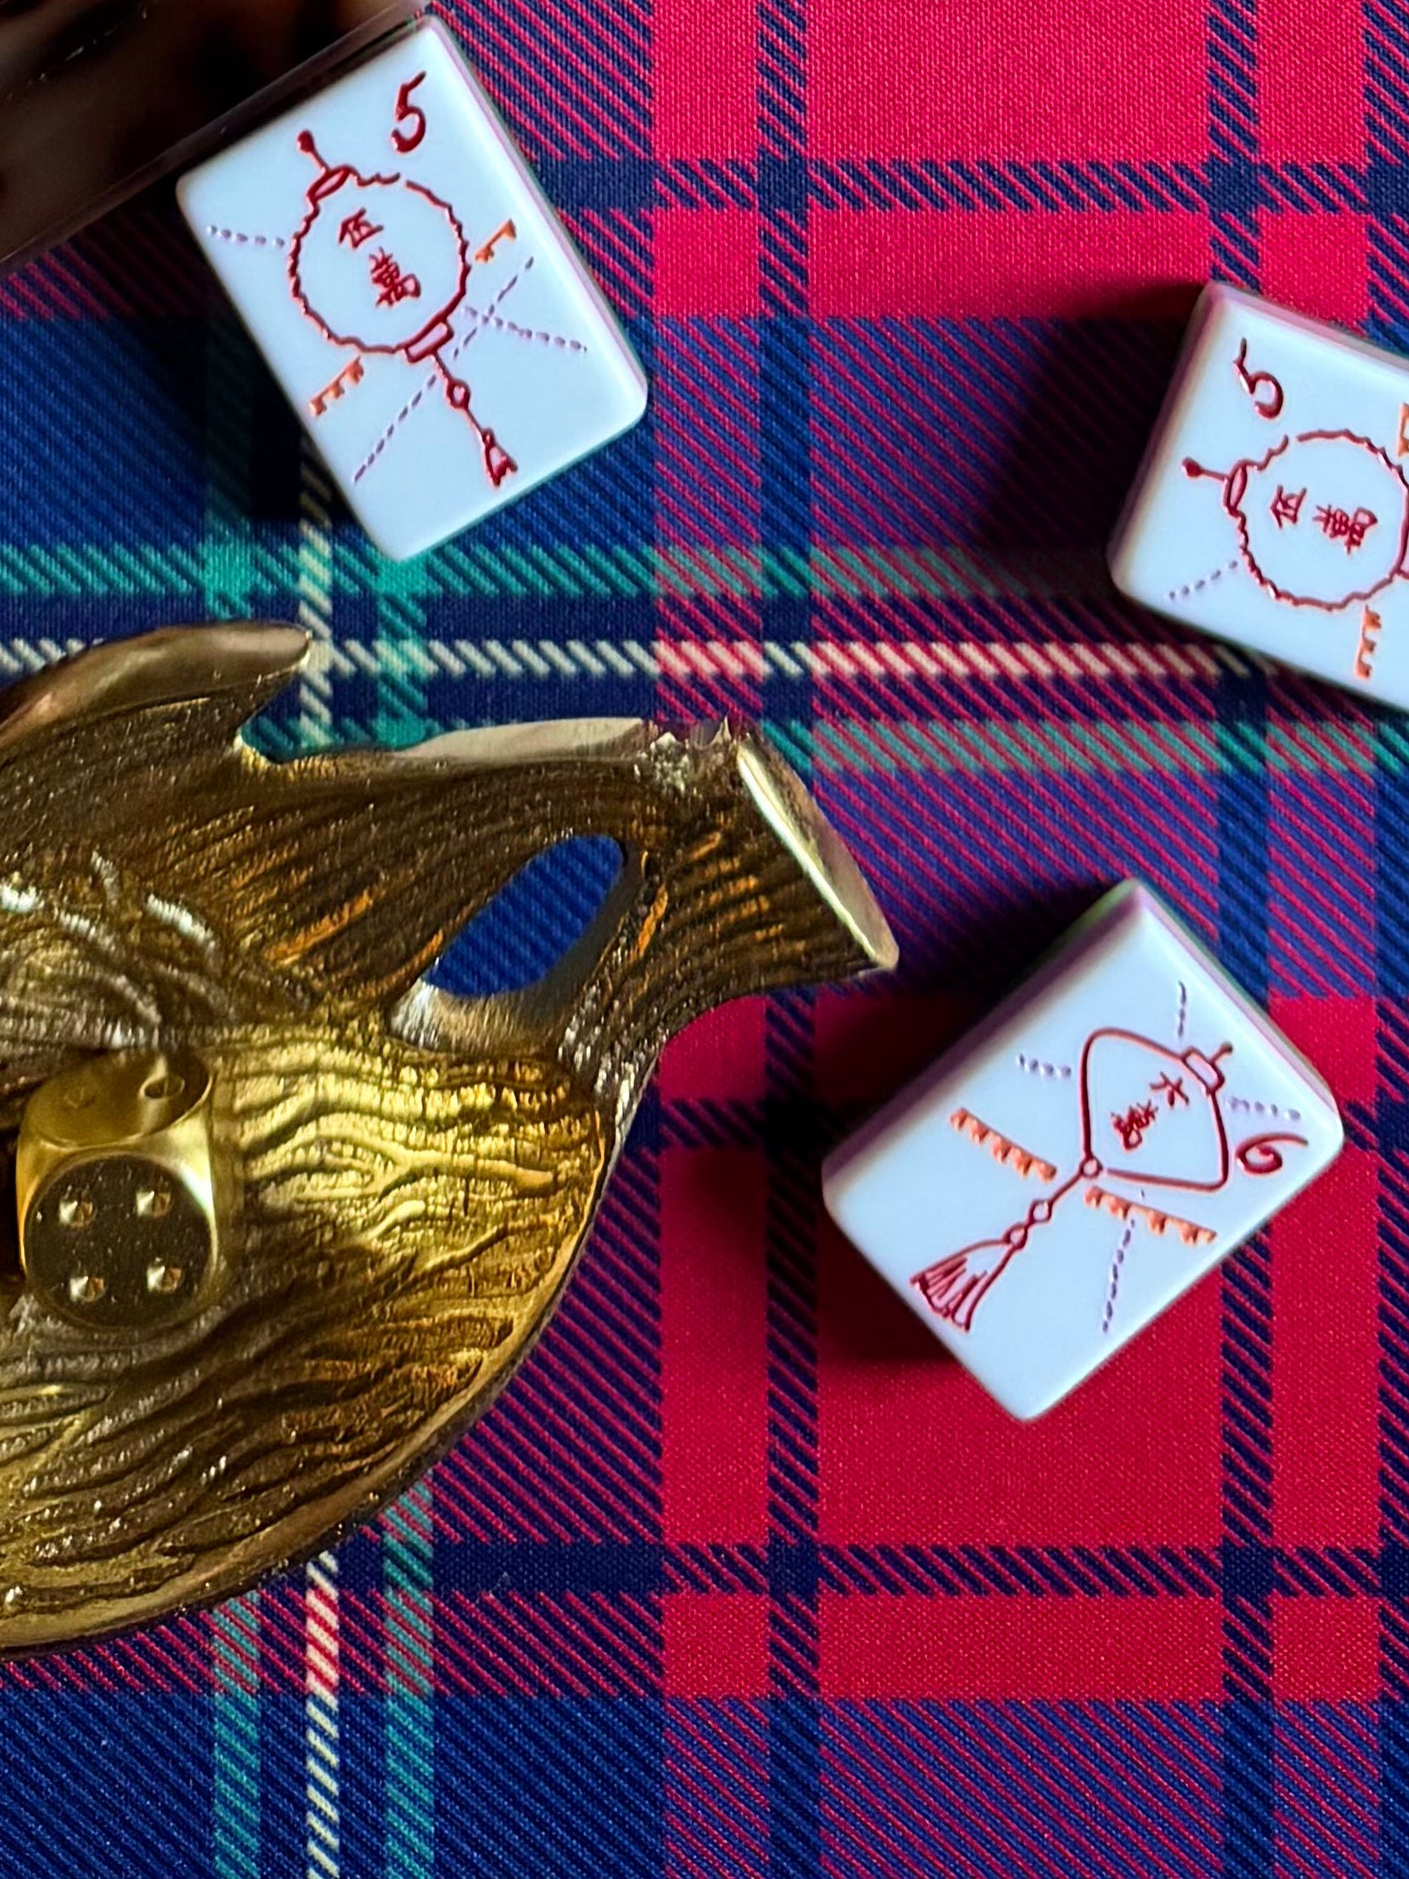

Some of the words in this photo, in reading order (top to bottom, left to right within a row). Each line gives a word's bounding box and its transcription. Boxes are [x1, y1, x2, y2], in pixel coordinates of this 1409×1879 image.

[390, 71, 427, 154] 5
[1233, 337, 1285, 420] 5
[1235, 1133, 1308, 1175] 6
